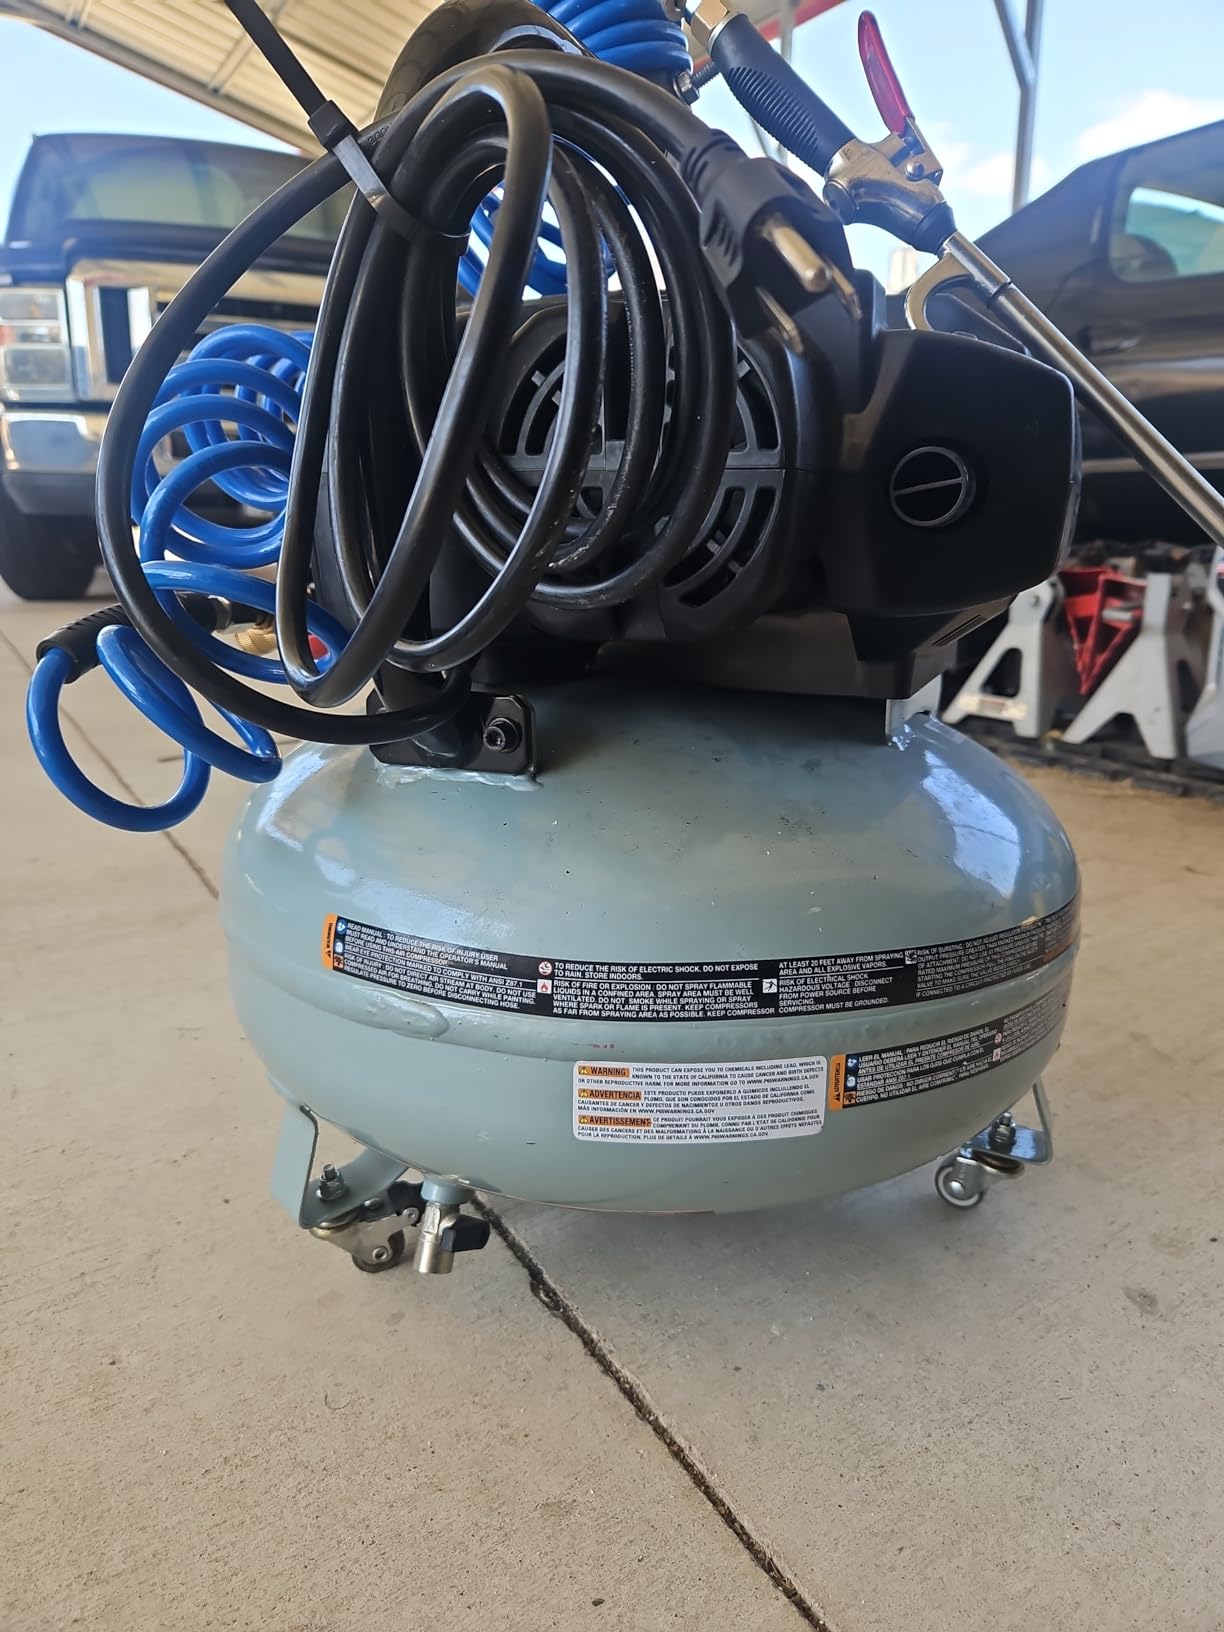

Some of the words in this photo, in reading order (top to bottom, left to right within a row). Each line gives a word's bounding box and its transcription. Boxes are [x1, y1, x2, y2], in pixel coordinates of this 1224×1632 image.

[875, 952, 903, 961] SPRAYING
[346, 945, 359, 954] WEAR
[371, 951, 405, 965] PROTECTION
[407, 960, 431, 971] MARKED
[443, 968, 469, 979] COMPLY
[471, 974, 487, 982] WITH
[828, 963, 860, 972] EXPLOSIVE
[364, 958, 382, 968] INJURY
[407, 968, 427, 979] DIRECT
[429, 974, 438, 983] AIR
[440, 978, 464, 989] STREAM
[807, 975, 845, 984] ELECTRICAL
[847, 973, 868, 981] SHOCK
[780, 984, 820, 992] HAZARDOUS
[822, 982, 849, 990] VOLTAGE
[855, 977, 892, 987] DISCONNECT
[825, 988, 851, 997] SOURCE
[853, 986, 876, 994] BEFORE
[727, 1008, 774, 1016] COMPRESSOR
[779, 1004, 824, 1013] COMPRESSOR
[826, 1002, 843, 1010] MUST
[591, 1067, 626, 1076] WARNING
[590, 1090, 640, 1099] ADVERTENCIA
[590, 1117, 650, 1126] AVERTISSEMENT
